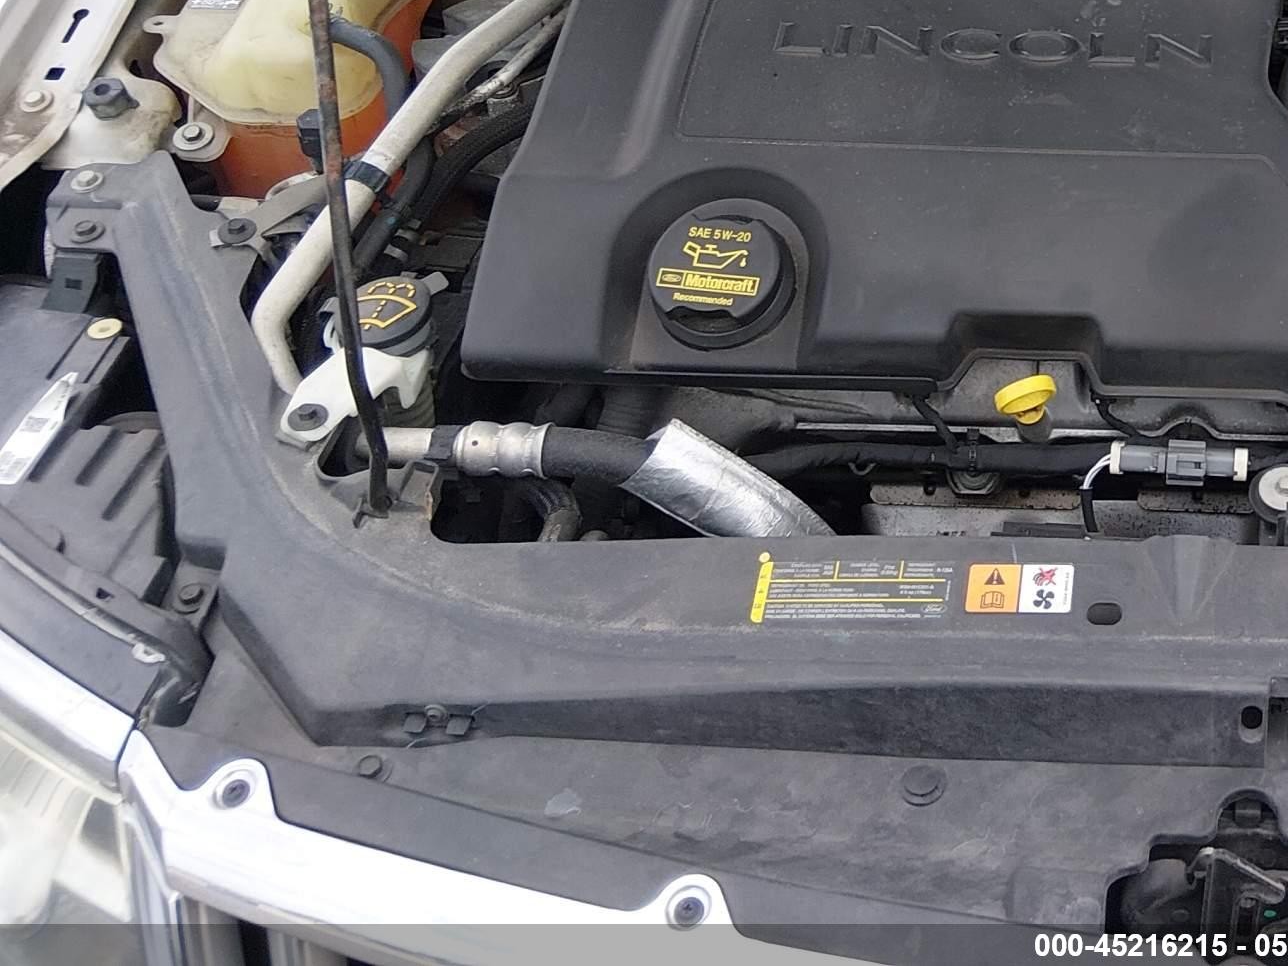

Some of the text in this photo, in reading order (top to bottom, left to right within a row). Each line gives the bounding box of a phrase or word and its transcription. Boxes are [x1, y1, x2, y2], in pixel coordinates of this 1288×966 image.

[774, 21, 1214, 68] LINCOLN
[688, 226, 752, 243] SAE 5W-20
[685, 273, 755, 293] Motorcraft
[672, 292, 734, 306] Recommended
